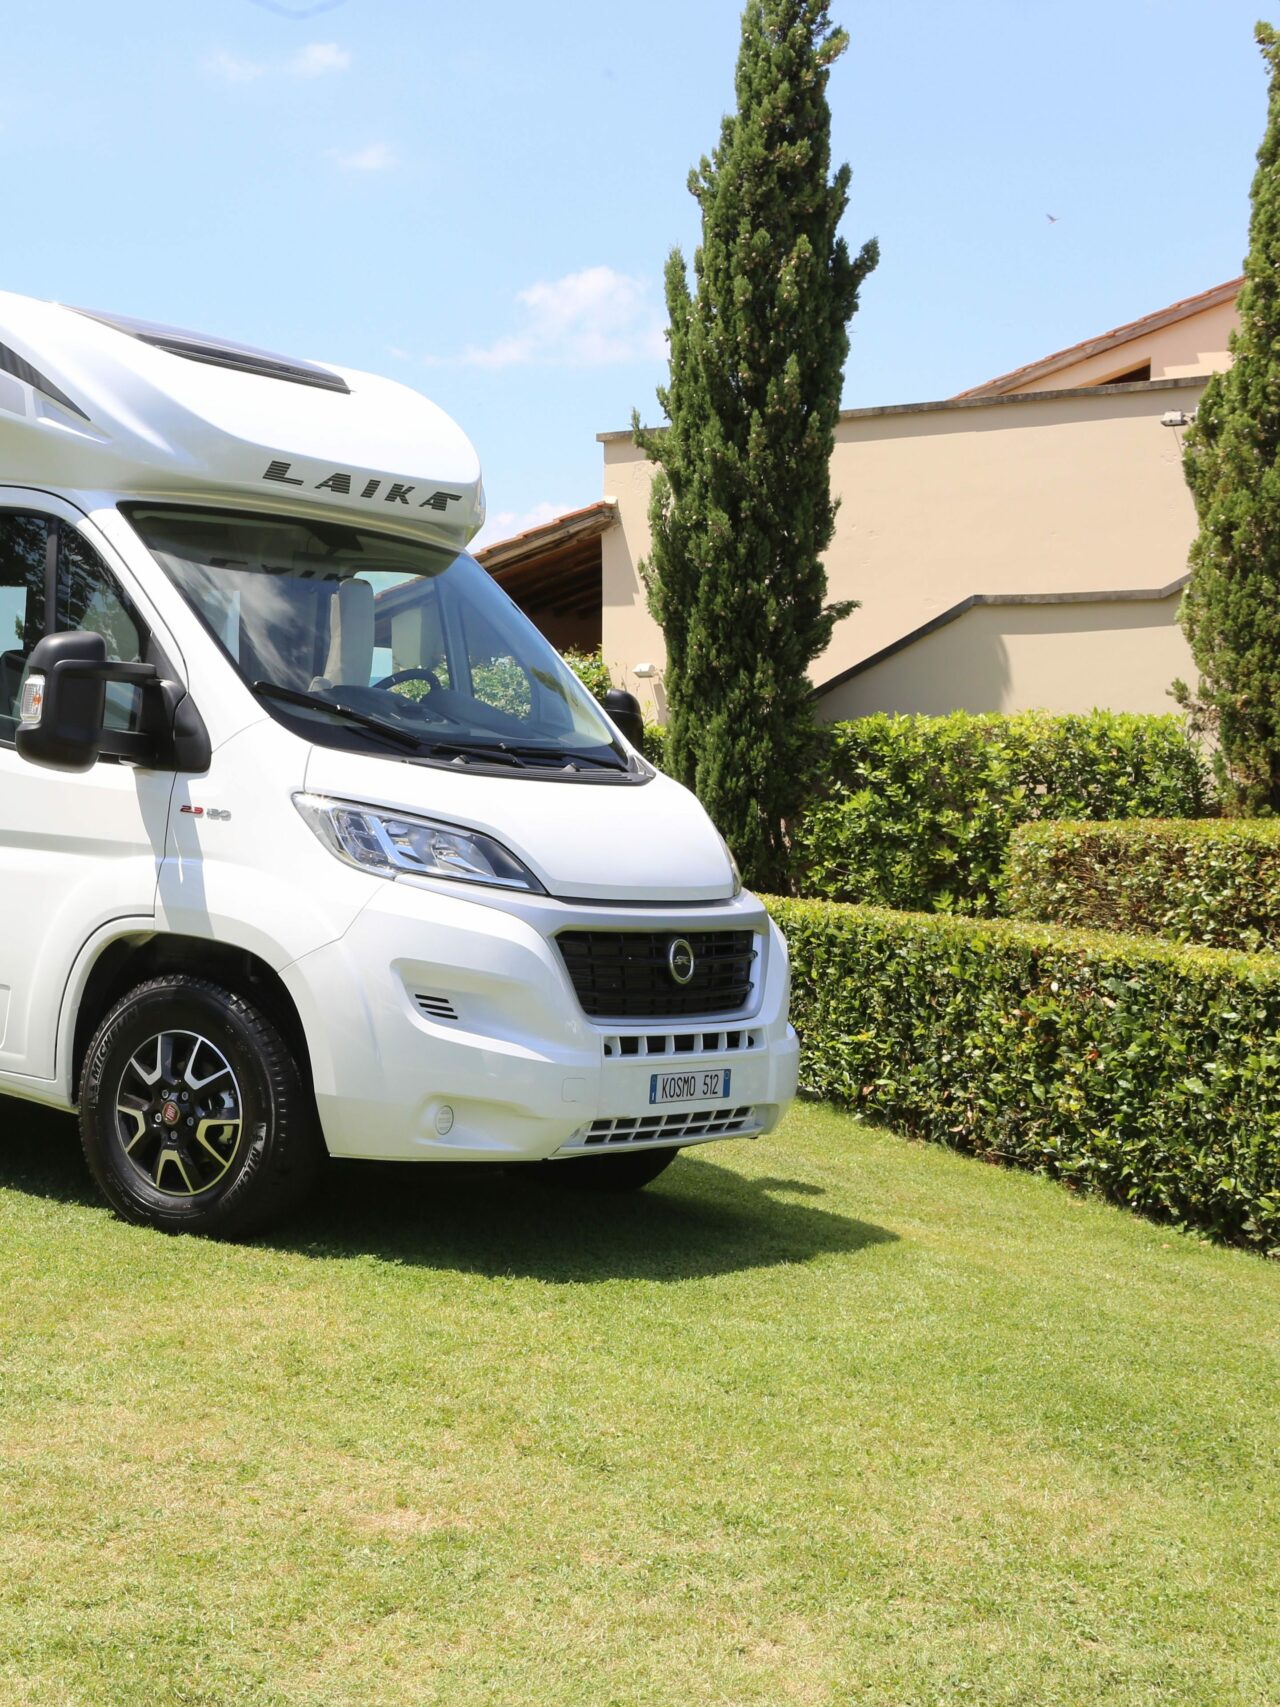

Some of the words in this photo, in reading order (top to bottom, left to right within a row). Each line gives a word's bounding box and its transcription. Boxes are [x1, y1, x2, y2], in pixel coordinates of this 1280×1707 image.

[262, 460, 463, 512] LAIKA
[661, 1075, 696, 1099] KOSMO
[702, 1074, 719, 1095] 512
